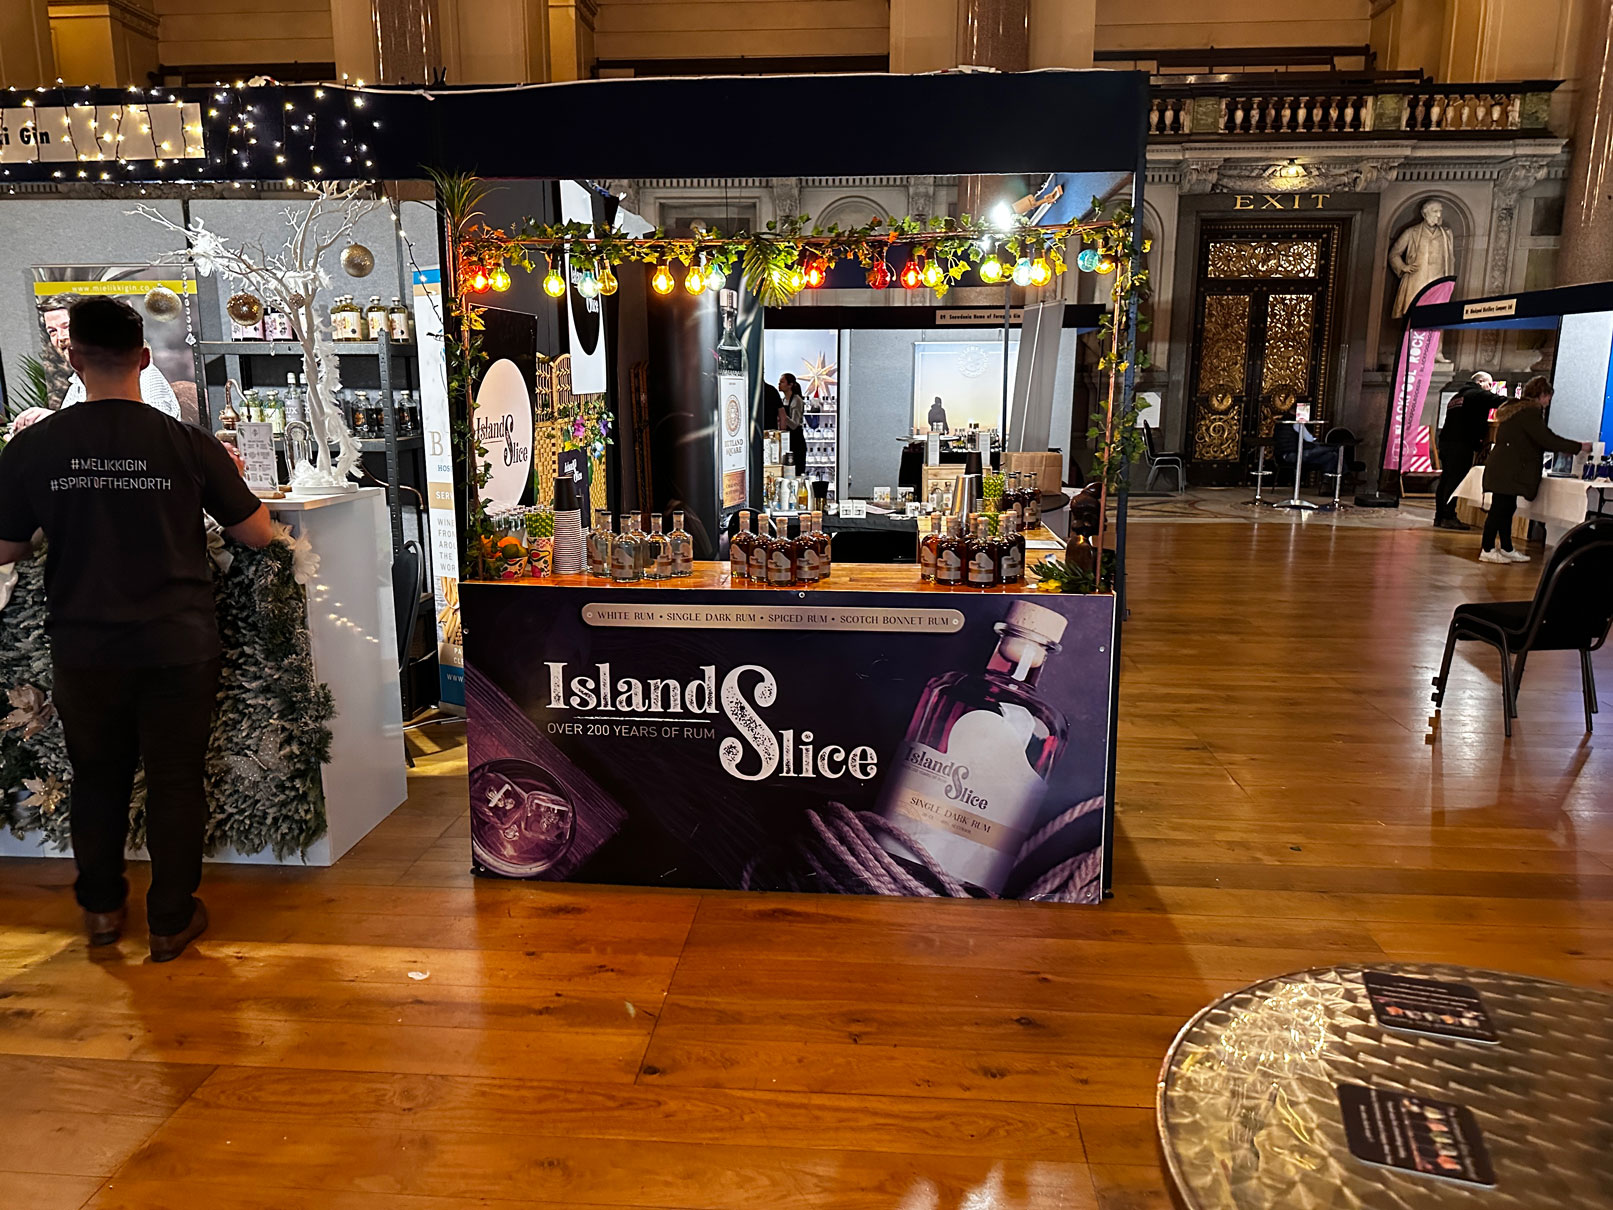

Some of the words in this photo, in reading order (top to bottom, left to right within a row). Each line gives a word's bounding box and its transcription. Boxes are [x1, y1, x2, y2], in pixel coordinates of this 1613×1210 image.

[20, 126, 50, 145] Gin
[1233, 194, 1330, 209] EXIT
[1409, 331, 1426, 364] ROCK
[476, 415, 505, 441] Island
[503, 414, 528, 467] Slice
[439, 551, 453, 561] THE
[597, 611, 631, 621] WHITE
[634, 611, 655, 621] RUM
[666, 612, 702, 622] SINGLE
[705, 612, 732, 622] DARK
[735, 613, 757, 623] RUM
[768, 614, 804, 623] SPICED
[807, 614, 828, 624] RUM
[840, 615, 879, 625] SCOTCH
[882, 616, 924, 625] BONNET
[928, 617, 950, 627] RUM
[543, 662, 720, 714] Island
[547, 722, 583, 735] OVER
[586, 724, 610, 736] 200
[613, 725, 658, 738] YEARS
[661, 726, 680, 738] OF
[683, 727, 716, 739] RUM
[719, 664, 878, 781] Slice
[905, 746, 955, 777] Island
[944, 765, 988, 810] Slice
[910, 796, 941, 814] SINGLE
[944, 809, 968, 825] DARK
[971, 819, 991, 833] RUM
